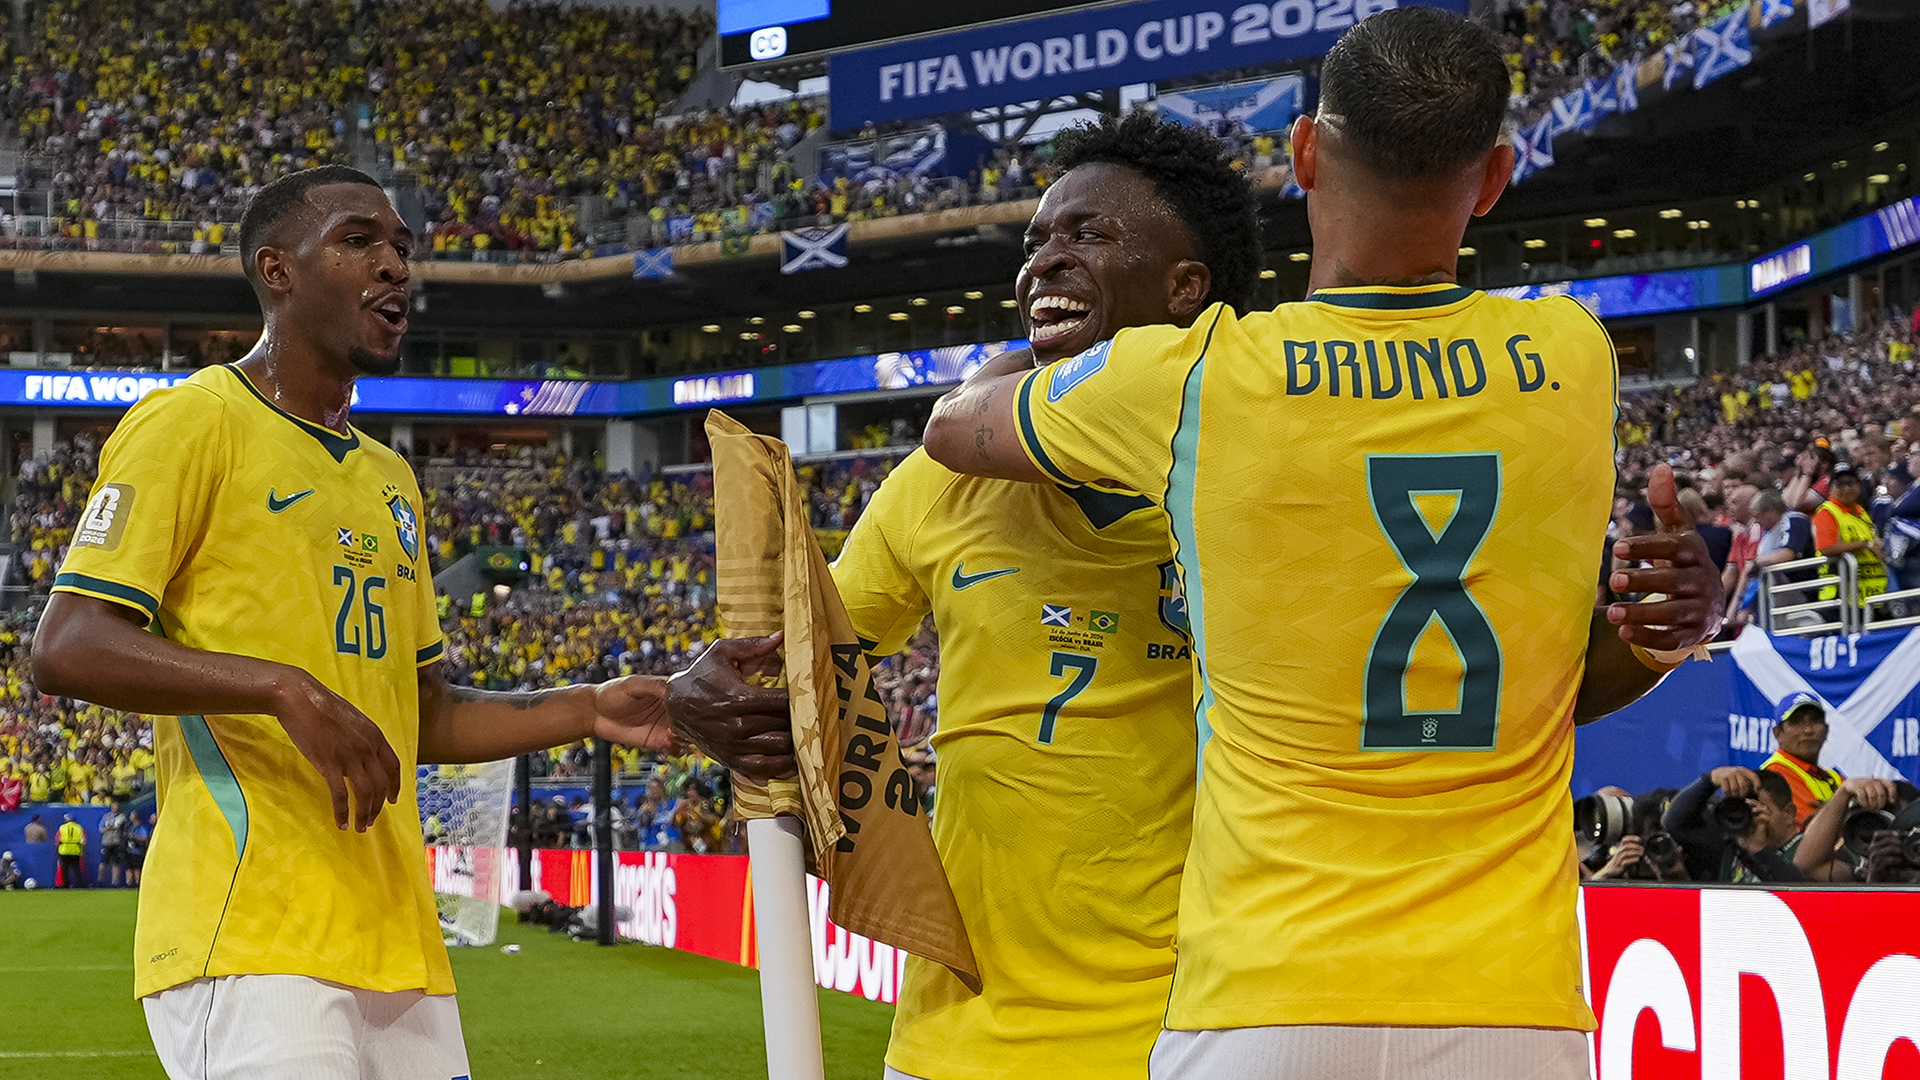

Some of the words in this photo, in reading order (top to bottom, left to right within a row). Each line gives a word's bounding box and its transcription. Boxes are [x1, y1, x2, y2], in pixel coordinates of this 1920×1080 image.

[755, 33, 780, 53] CC
[878, 53, 968, 103] FIFA
[970, 28, 1129, 88] WORLD
[1133, 11, 1226, 61] CUP
[25, 375, 88, 401] FIFA
[90, 377, 187, 402] WOR
[1283, 337, 1487, 400] BRUNO
[1505, 333, 1561, 393] G.
[332, 564, 388, 660] 26
[1359, 450, 1504, 752] 8
[1037, 650, 1099, 745] 7
[1147, 643, 1191, 660] BRA
[836, 673, 892, 854] WORL
